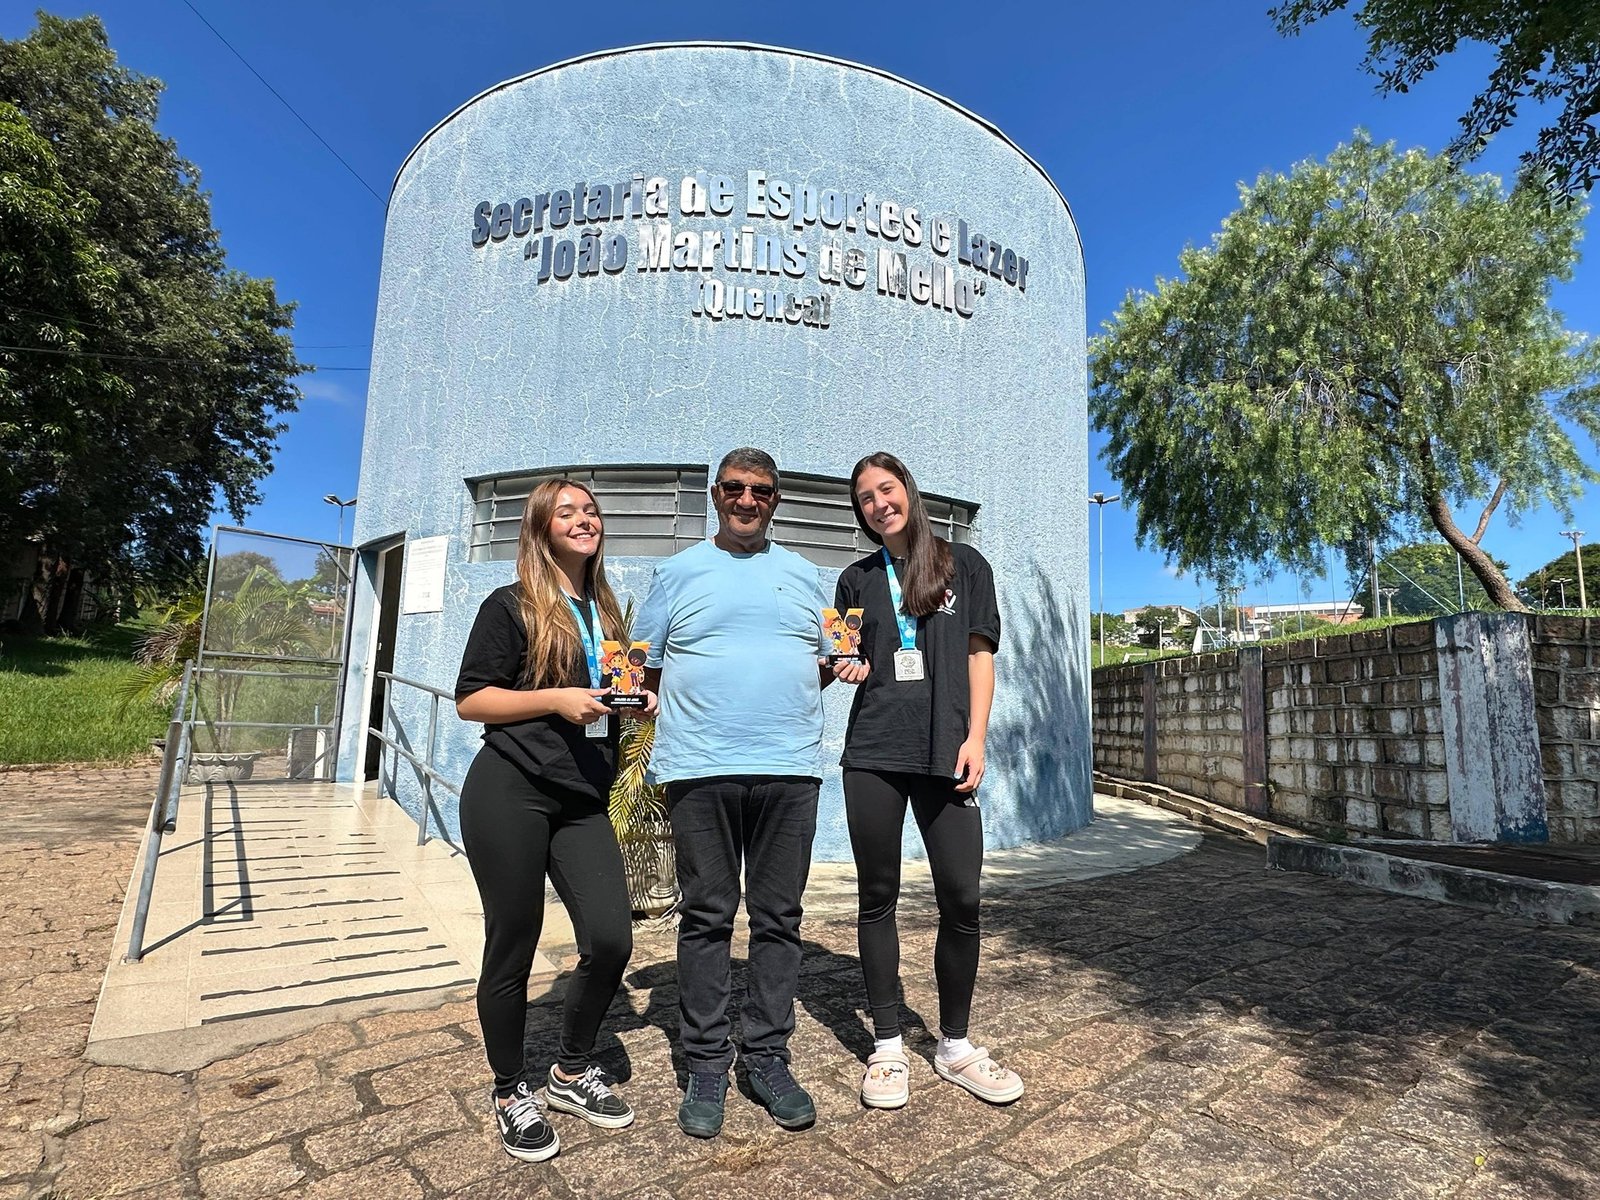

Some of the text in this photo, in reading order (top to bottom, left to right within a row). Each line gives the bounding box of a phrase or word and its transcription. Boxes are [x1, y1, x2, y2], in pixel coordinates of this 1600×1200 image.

[472, 170, 1029, 293] Secretaria de Esportes e Lazer
[637, 224, 807, 279] Martins
[819, 237, 867, 290] de
